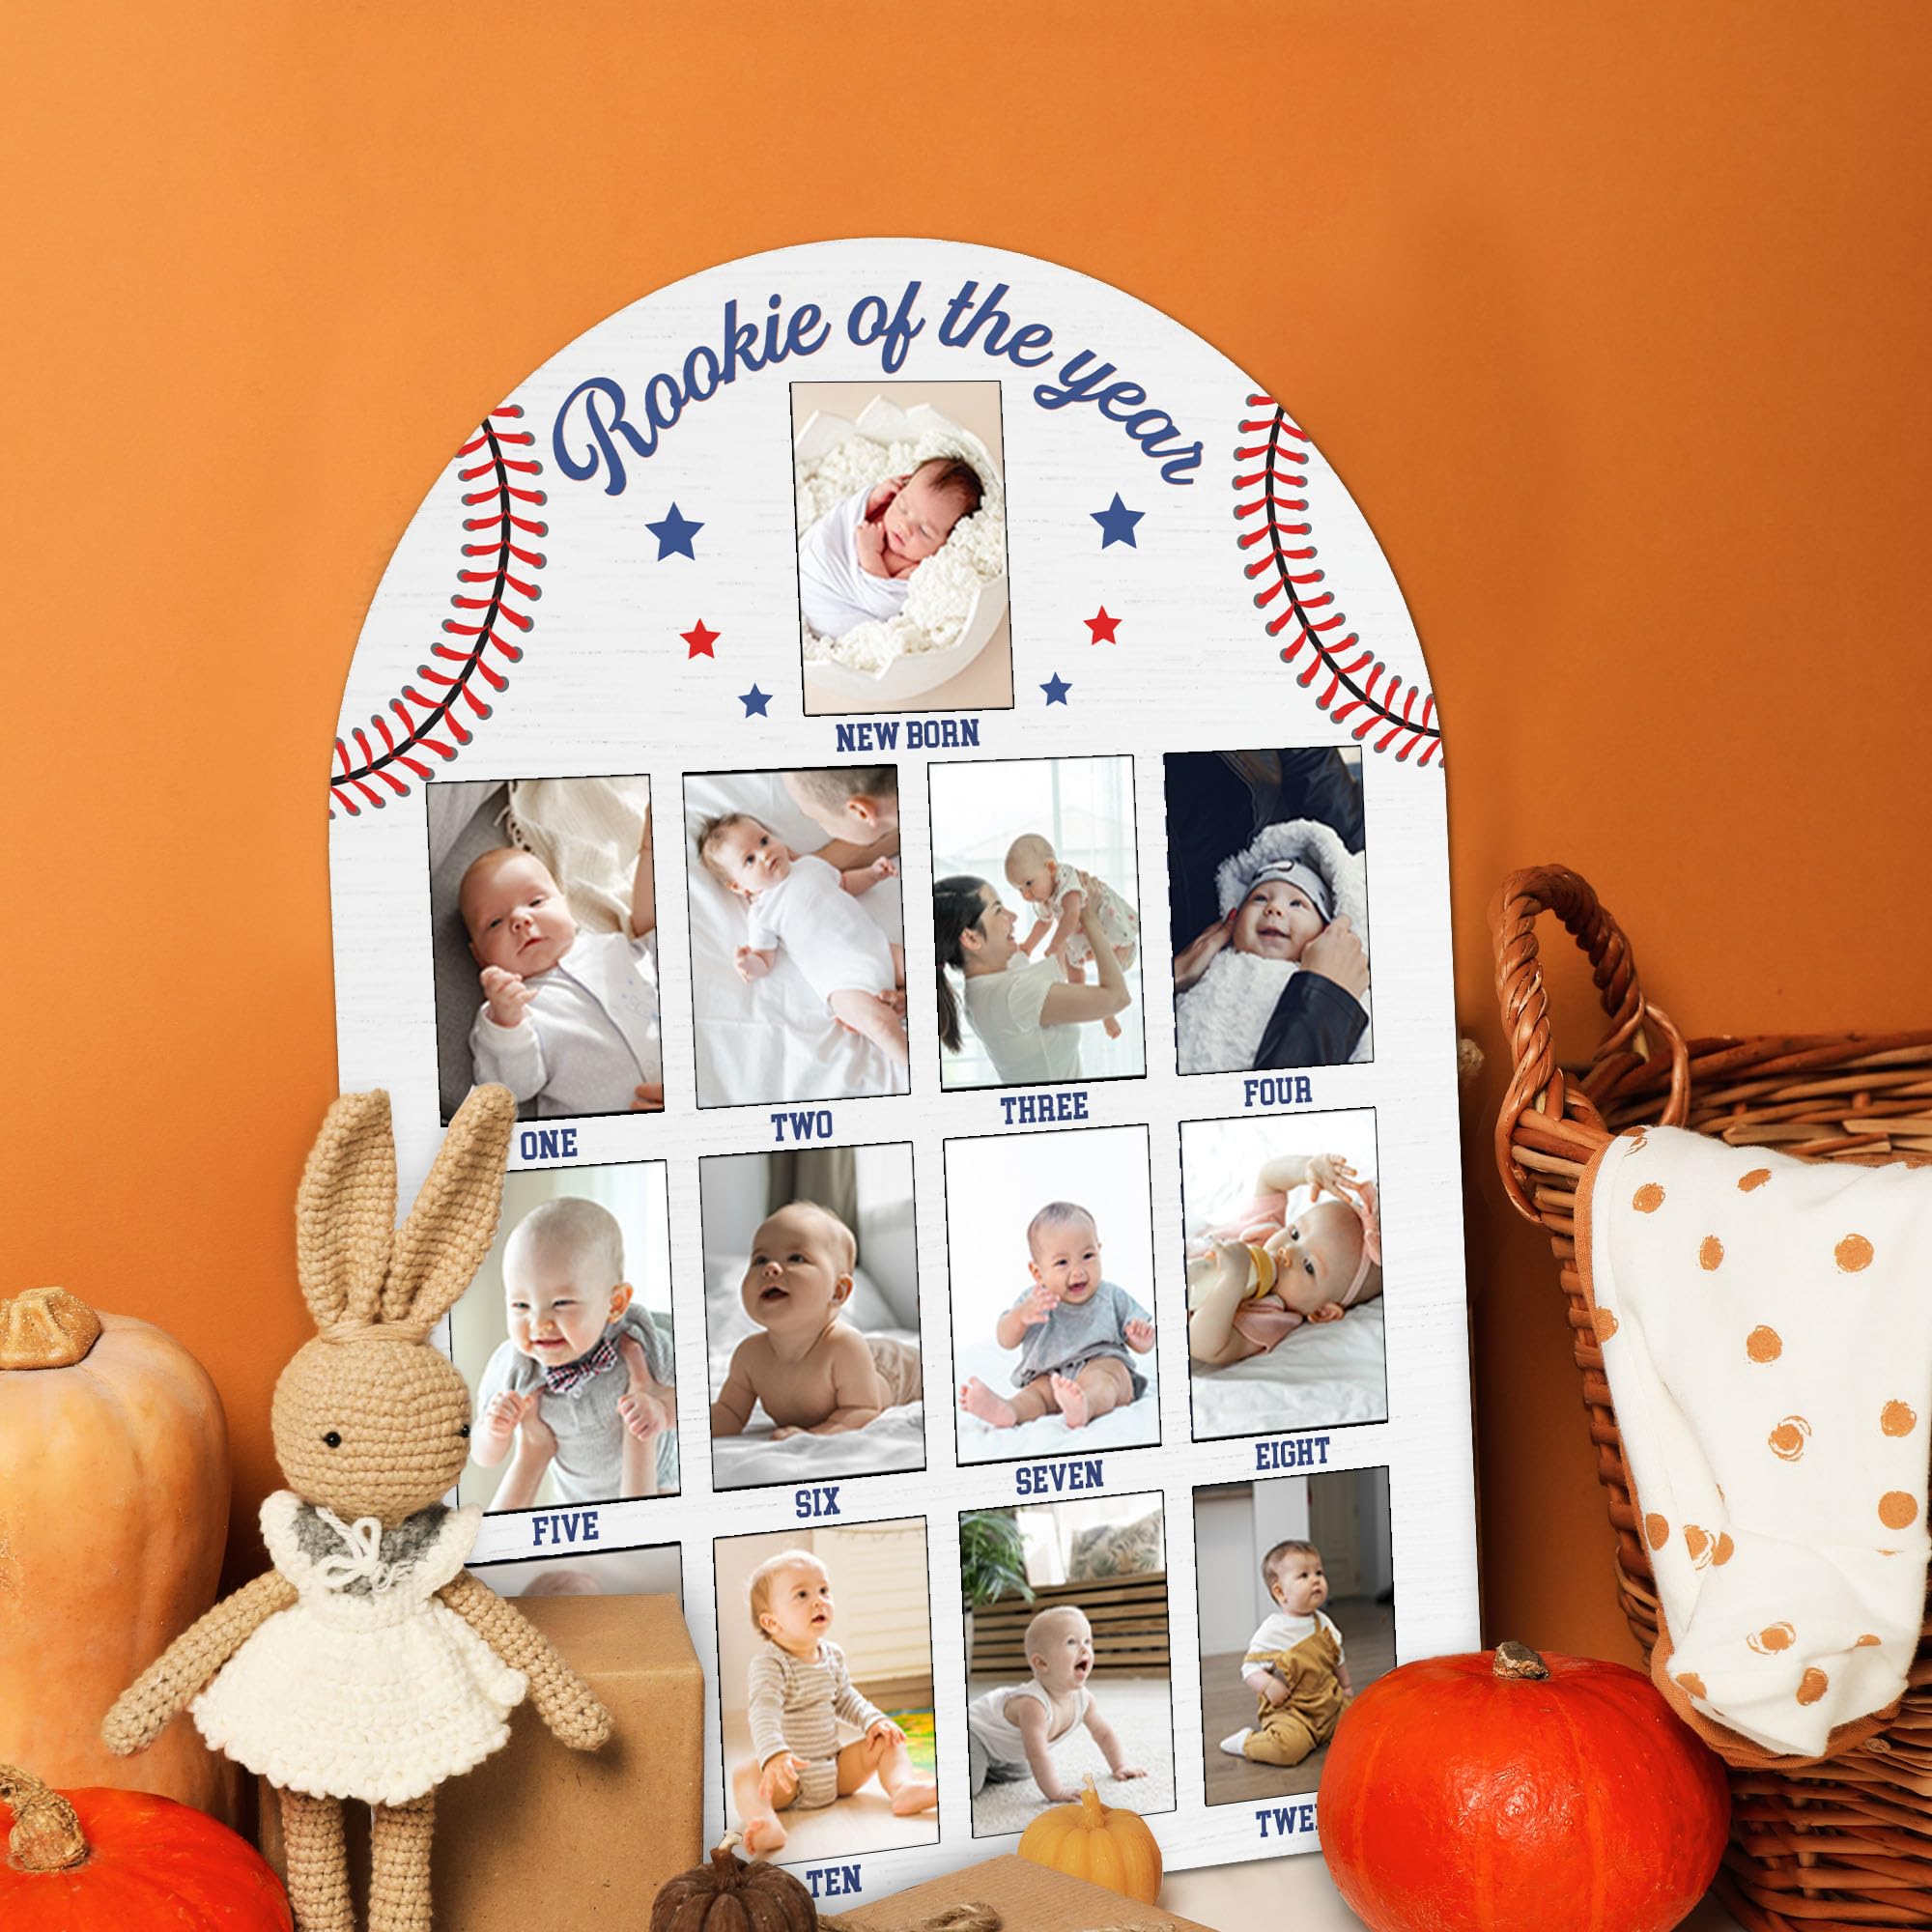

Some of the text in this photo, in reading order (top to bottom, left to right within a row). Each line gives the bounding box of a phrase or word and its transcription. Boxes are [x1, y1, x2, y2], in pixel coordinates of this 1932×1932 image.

[553, 280, 1204, 496] Rookie of the year
[836, 719, 980, 752] NEW BORN
[1244, 1076, 1313, 1106] FOUR
[1000, 1092, 1089, 1124] THREE
[771, 1110, 833, 1142] TWO
[521, 1128, 578, 1160] ONE
[1256, 1436, 1330, 1469] EIGHT
[1015, 1460, 1103, 1494] SEVEN
[795, 1486, 840, 1518] SIX
[532, 1511, 599, 1546] FIVE
[1256, 1804, 1318, 1837] TWE
[806, 1864, 863, 1898] TEN
